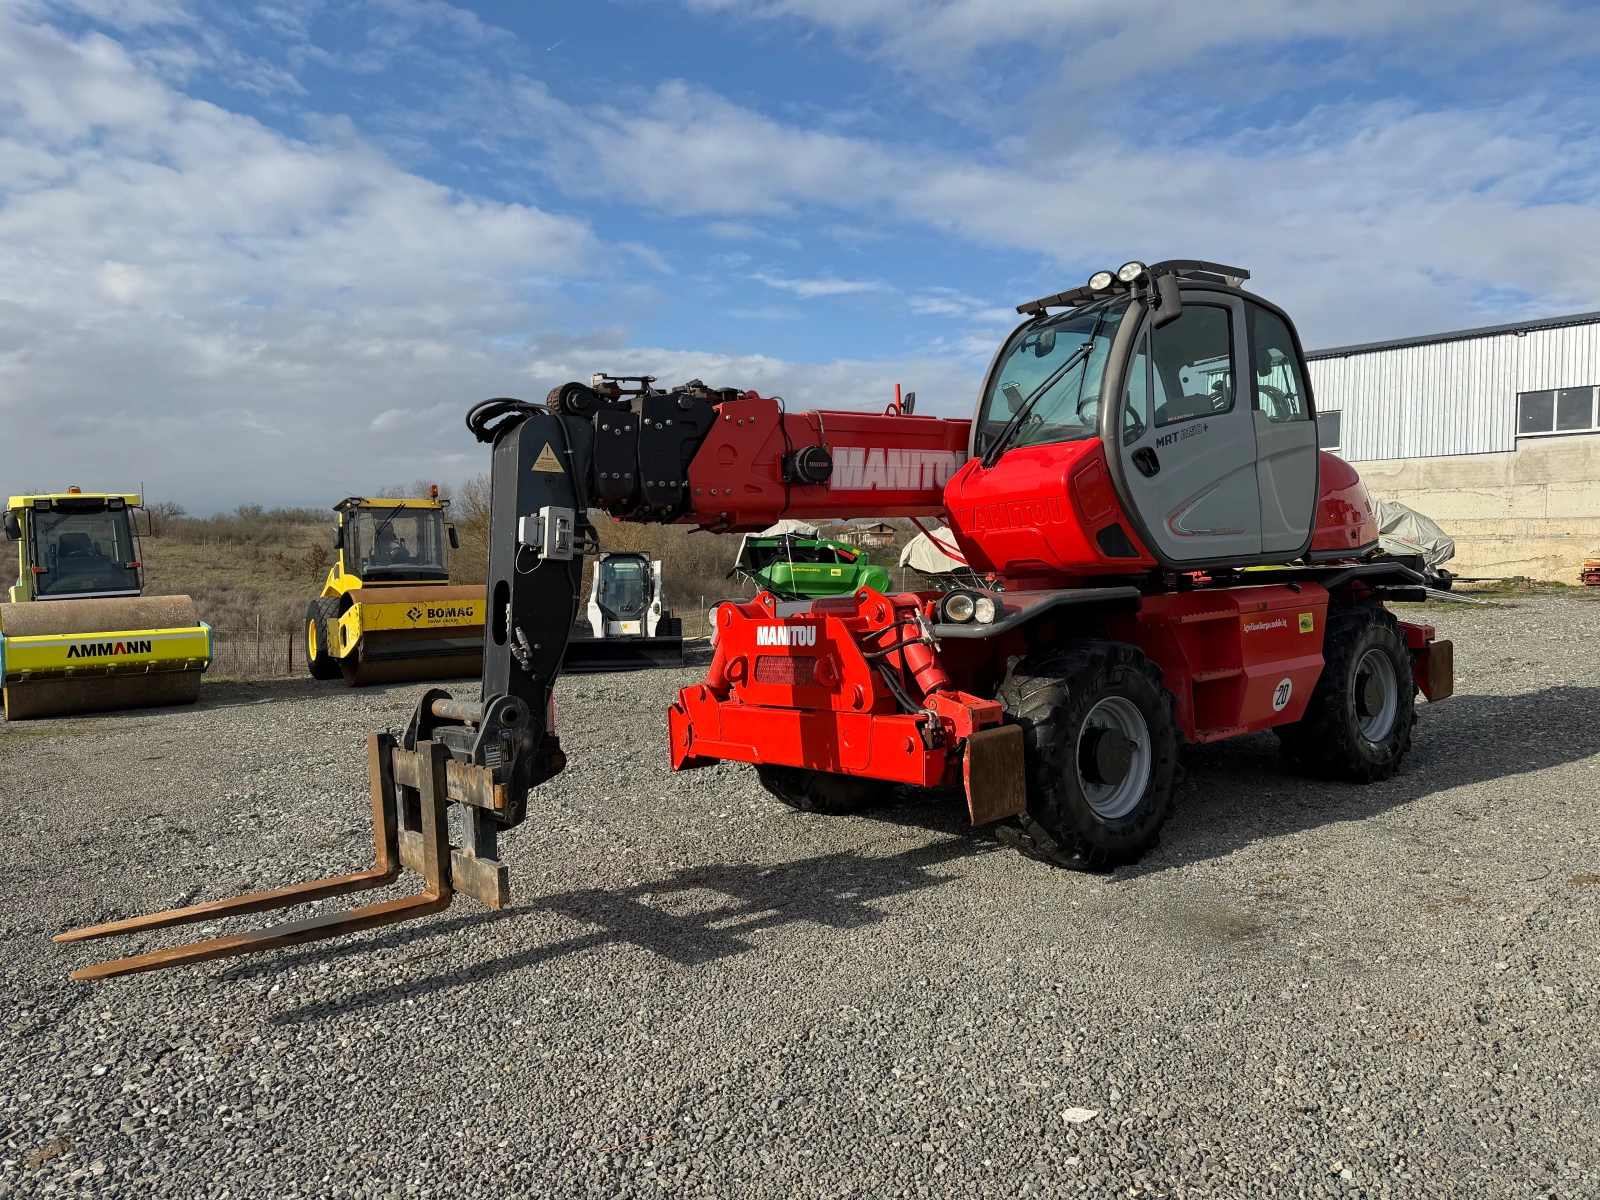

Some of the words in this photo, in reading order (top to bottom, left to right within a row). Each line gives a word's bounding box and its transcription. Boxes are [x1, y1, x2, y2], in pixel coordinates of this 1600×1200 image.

[1155, 431, 1179, 448] MRT
[427, 606, 474, 619] BOMAG
[757, 625, 816, 646] MANITOU
[66, 640, 152, 658] AMMANN
[1275, 683, 1290, 706] 20
